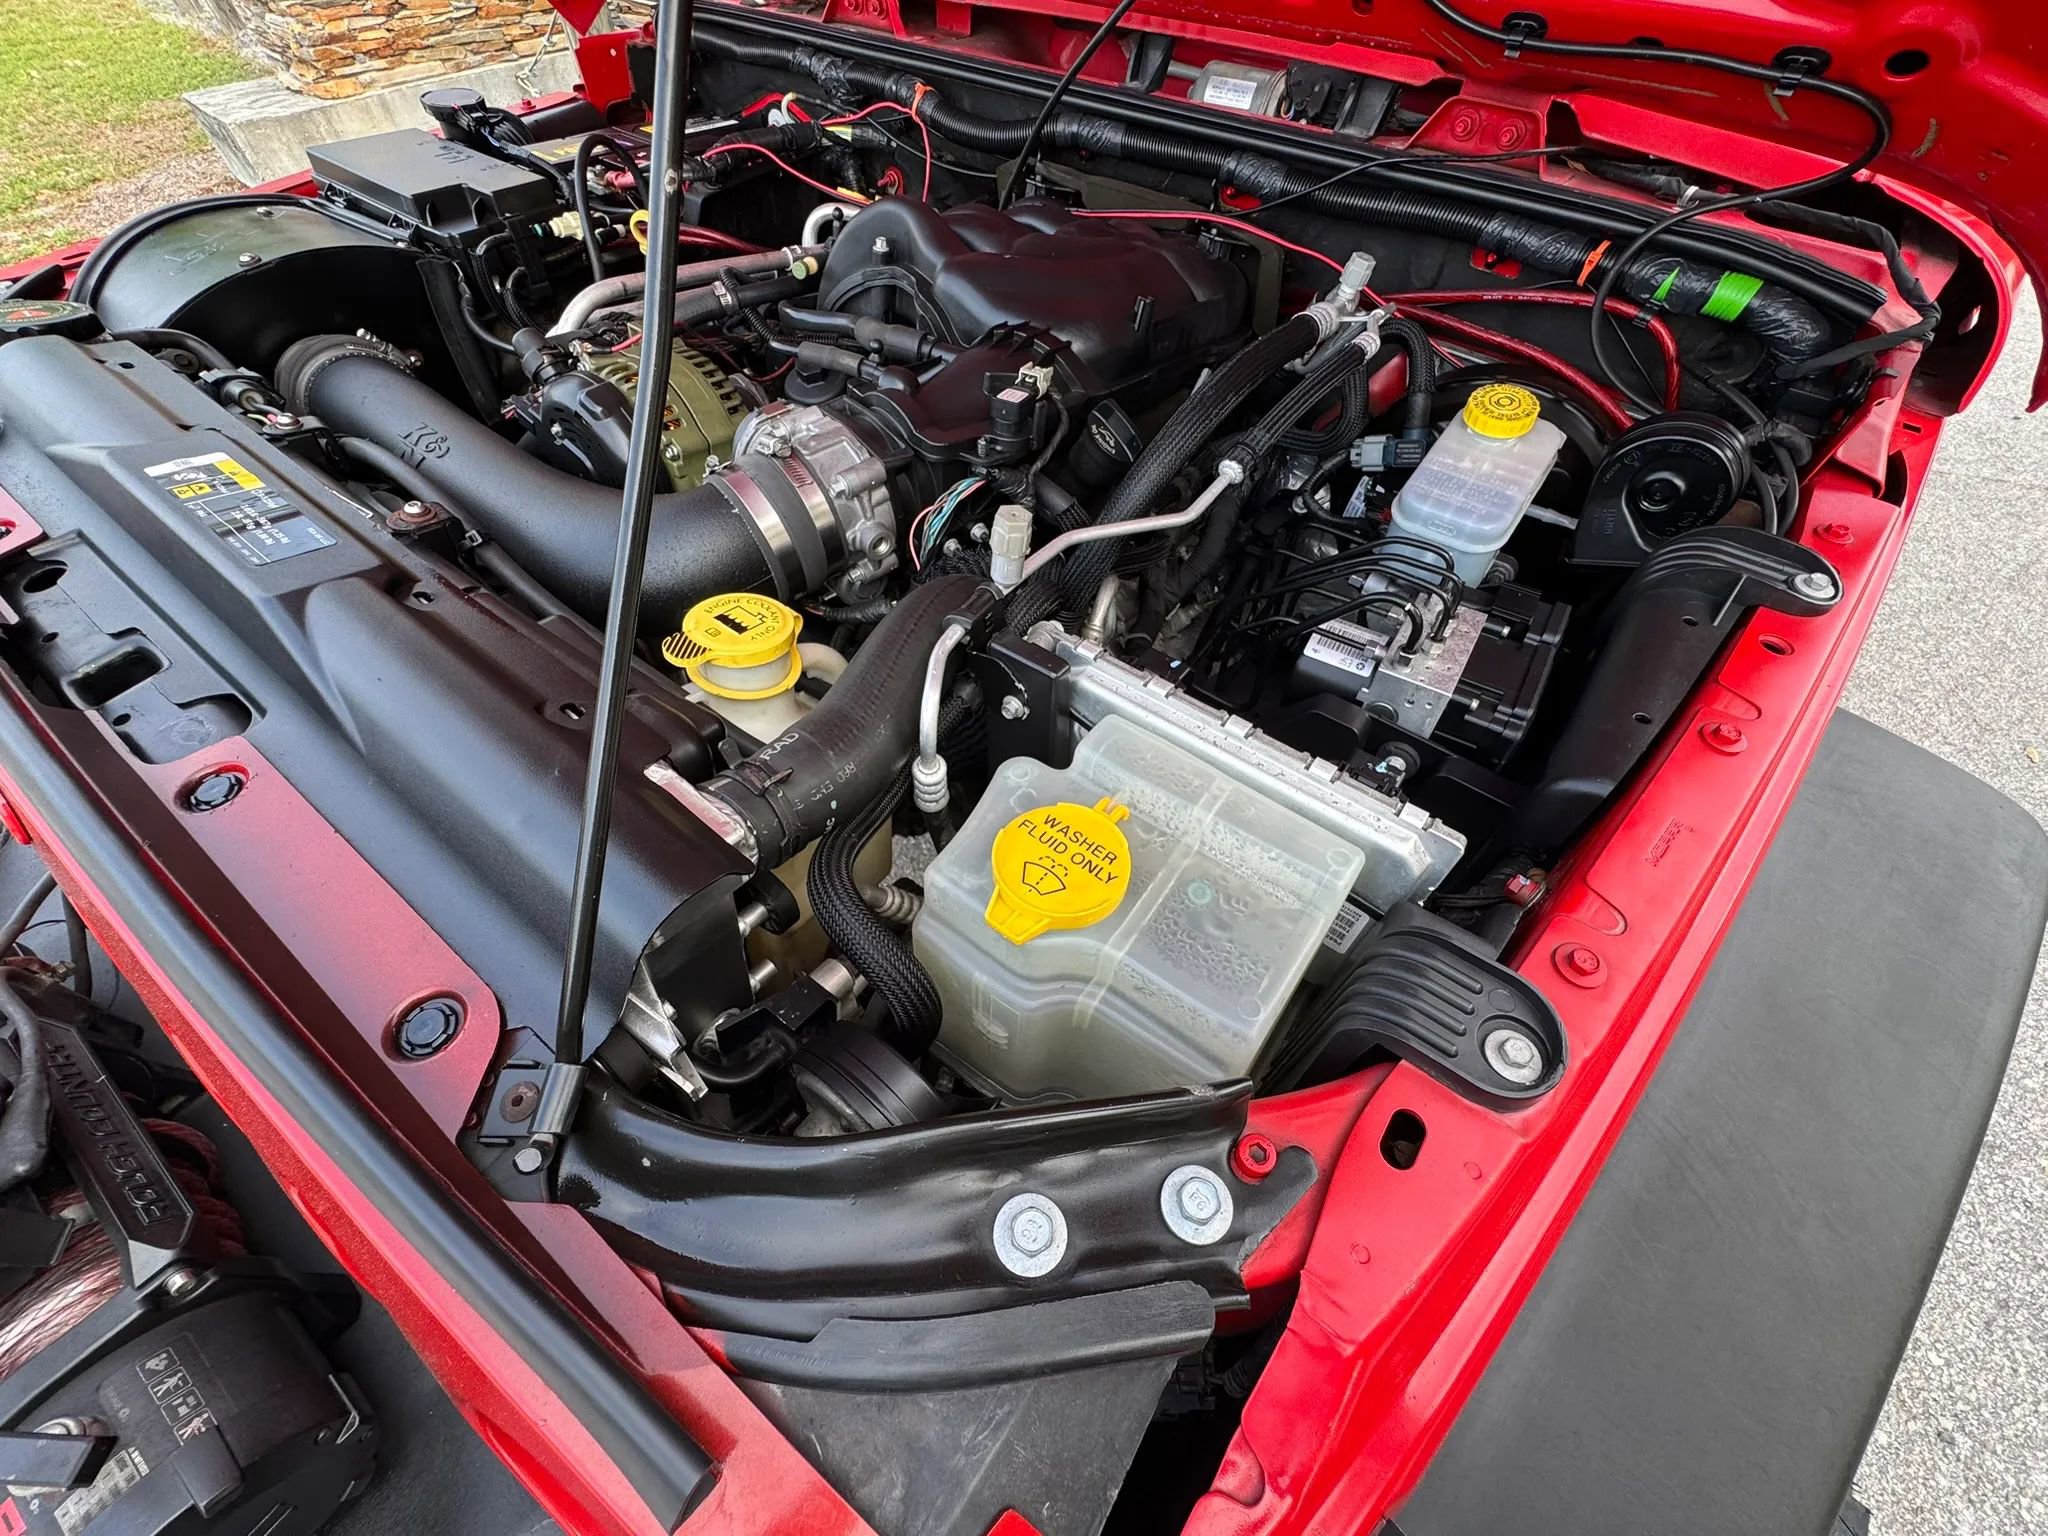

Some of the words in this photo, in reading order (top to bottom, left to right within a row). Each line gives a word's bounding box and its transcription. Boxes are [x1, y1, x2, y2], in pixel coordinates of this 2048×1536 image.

[397, 421, 451, 470] K&N
[1094, 433, 1116, 455] ENGINE
[704, 598, 742, 614] ENGINE
[746, 598, 780, 625] COOLANT
[750, 624, 776, 642] ONLY
[760, 732, 800, 761] RAD
[1018, 819, 1068, 854] FLUID
[1070, 852, 1119, 886] ONLY
[1043, 814, 1118, 866] WASHER
[45, 1041, 121, 1137] COUNTRY
[97, 1141, 173, 1228] ROUGH
